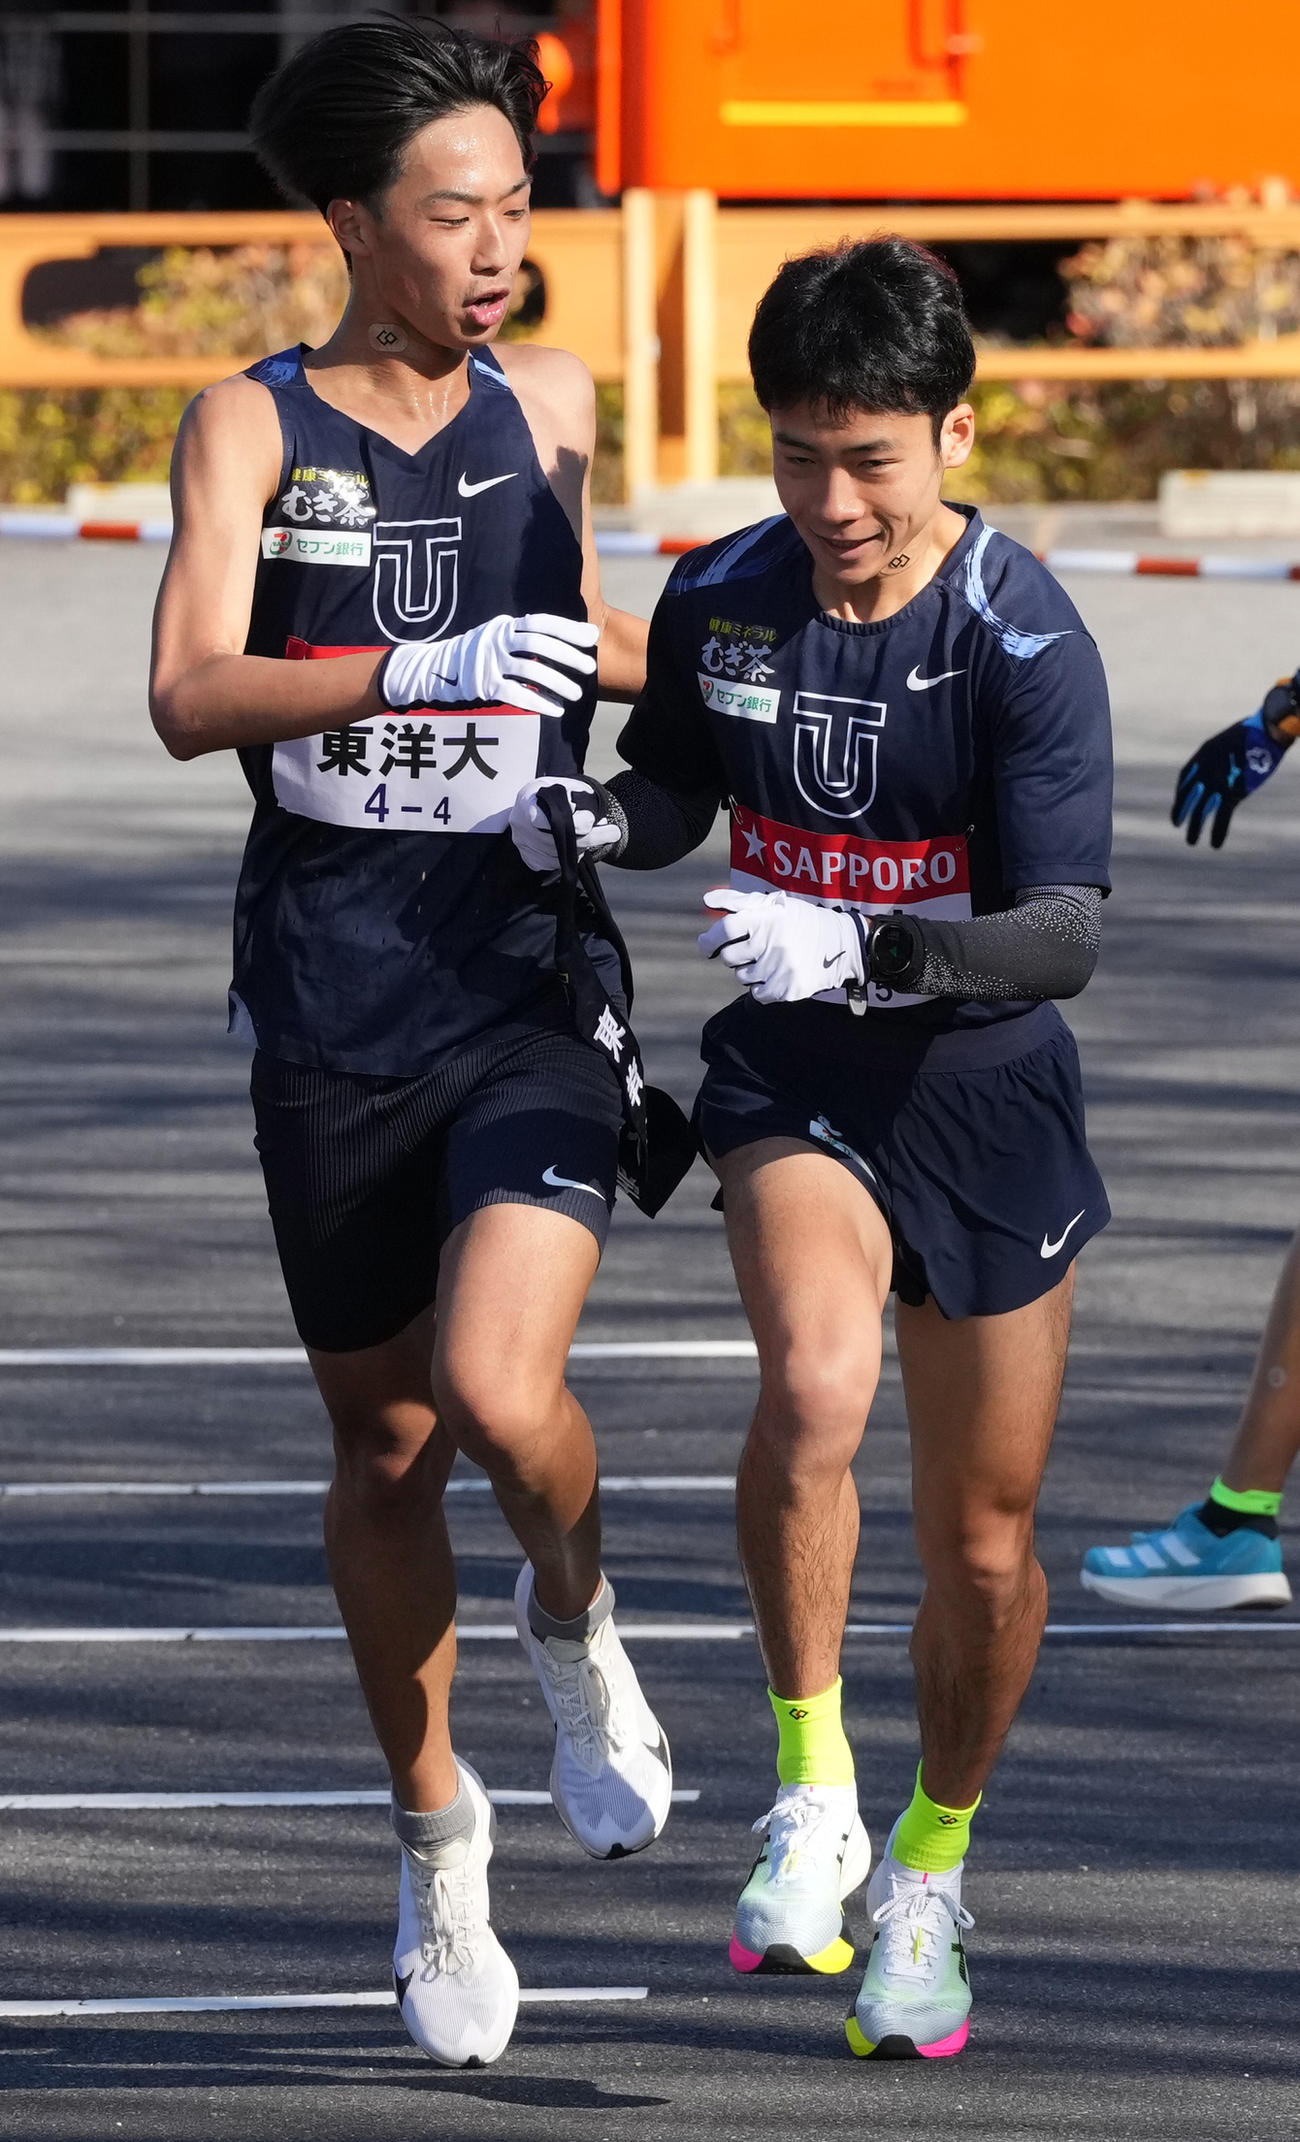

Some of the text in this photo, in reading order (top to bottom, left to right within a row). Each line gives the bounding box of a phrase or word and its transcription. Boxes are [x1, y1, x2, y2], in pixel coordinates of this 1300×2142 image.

[709, 617, 777, 642] 健康ミネラル
[701, 636, 776, 682] むぎ茶
[316, 722, 500, 780] 東洋大
[773, 839, 957, 891] SAPPORO
